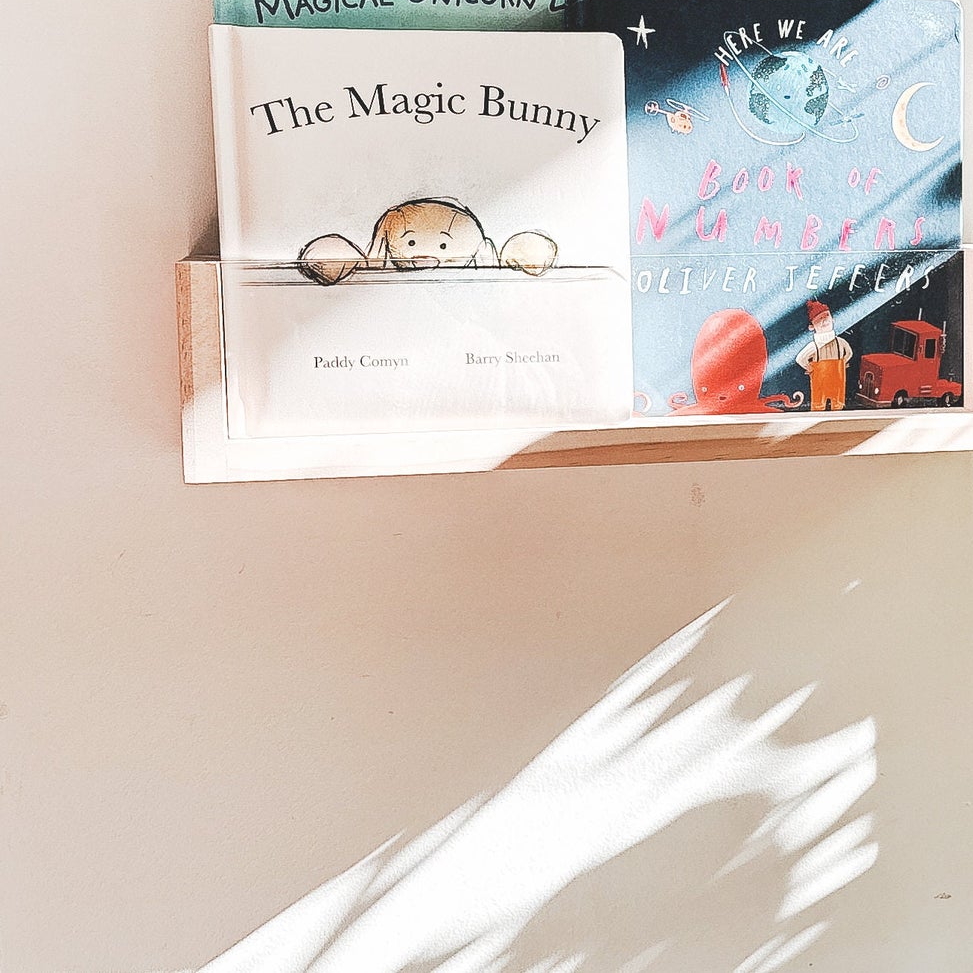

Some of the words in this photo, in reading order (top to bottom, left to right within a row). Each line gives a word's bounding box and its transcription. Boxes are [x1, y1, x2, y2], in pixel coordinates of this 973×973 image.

[714, 23, 763, 66] HERE
[778, 19, 806, 39] WE
[816, 29, 859, 68] ARE
[250, 97, 335, 136] The
[344, 82, 467, 125] Magic
[478, 84, 602, 144] Bunny
[698, 159, 804, 201] BOOK
[847, 167, 882, 195] OF
[635, 197, 926, 251] NUMBERS
[636, 266, 757, 293] OLIVER
[785, 264, 933, 292] JEFFERS
[313, 355, 354, 370] Paddy
[359, 355, 409, 370] Comyn
[465, 352, 501, 366] Barry
[505, 350, 561, 365] Sheehan
